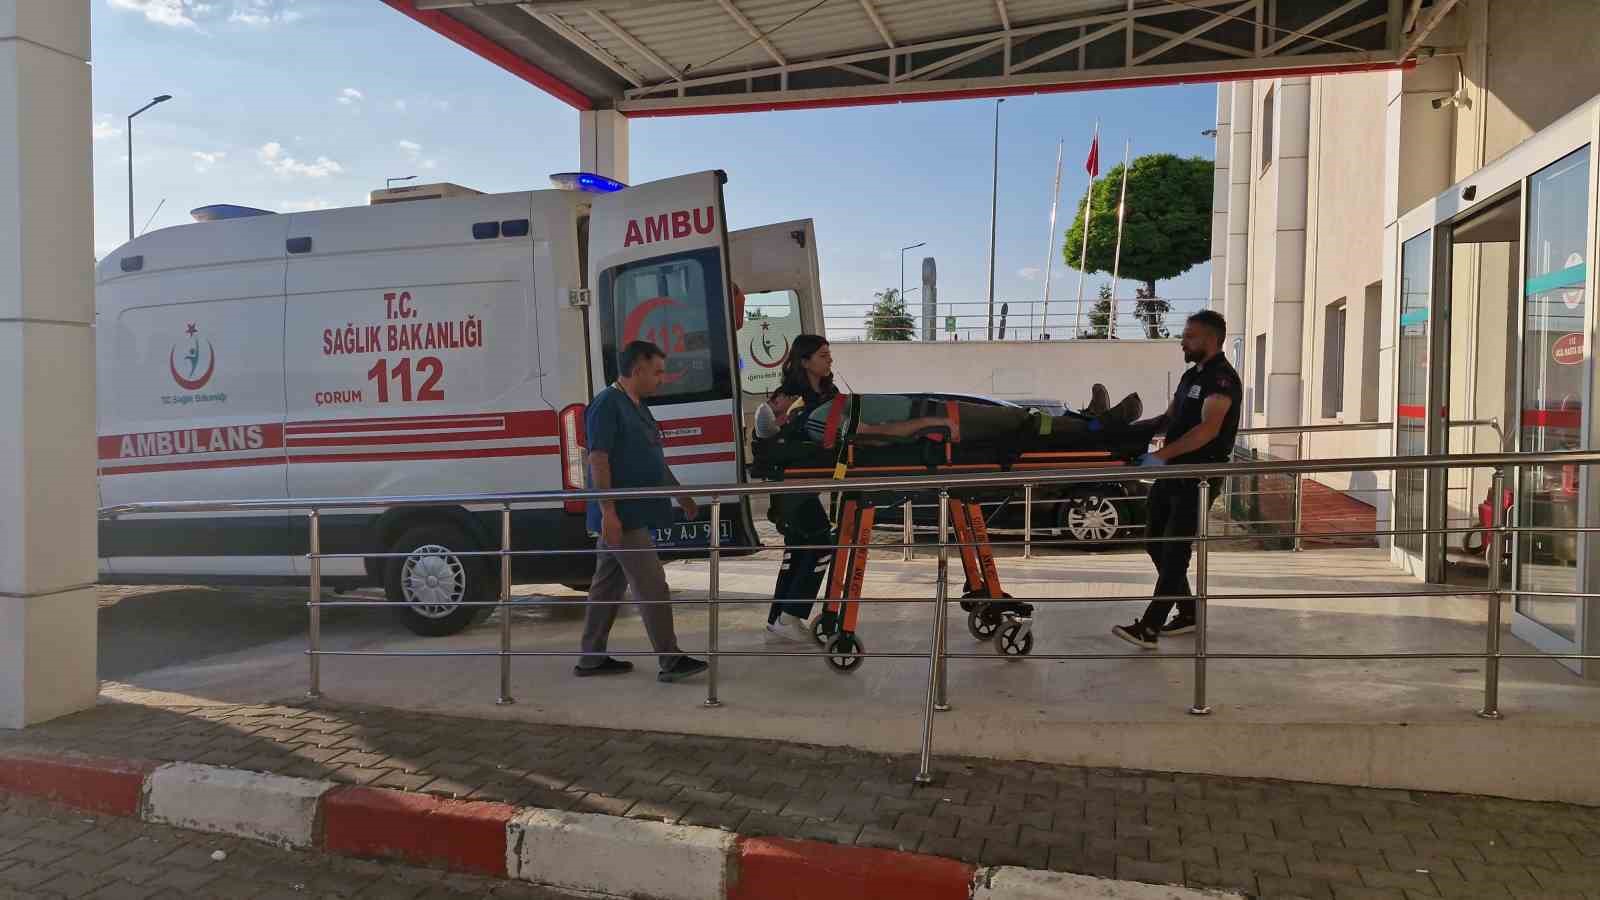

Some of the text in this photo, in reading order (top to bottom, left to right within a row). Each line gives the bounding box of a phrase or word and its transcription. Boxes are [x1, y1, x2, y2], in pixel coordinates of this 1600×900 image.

[624, 206, 715, 247] AMBU
[383, 291, 417, 320] T.C.
[323, 315, 483, 355] SAĞLIK BAKANLIĞI
[315, 356, 445, 406] ÇORUM 112
[119, 425, 264, 458] AMBULANS
[656, 522, 729, 542] 19 AJ 91
